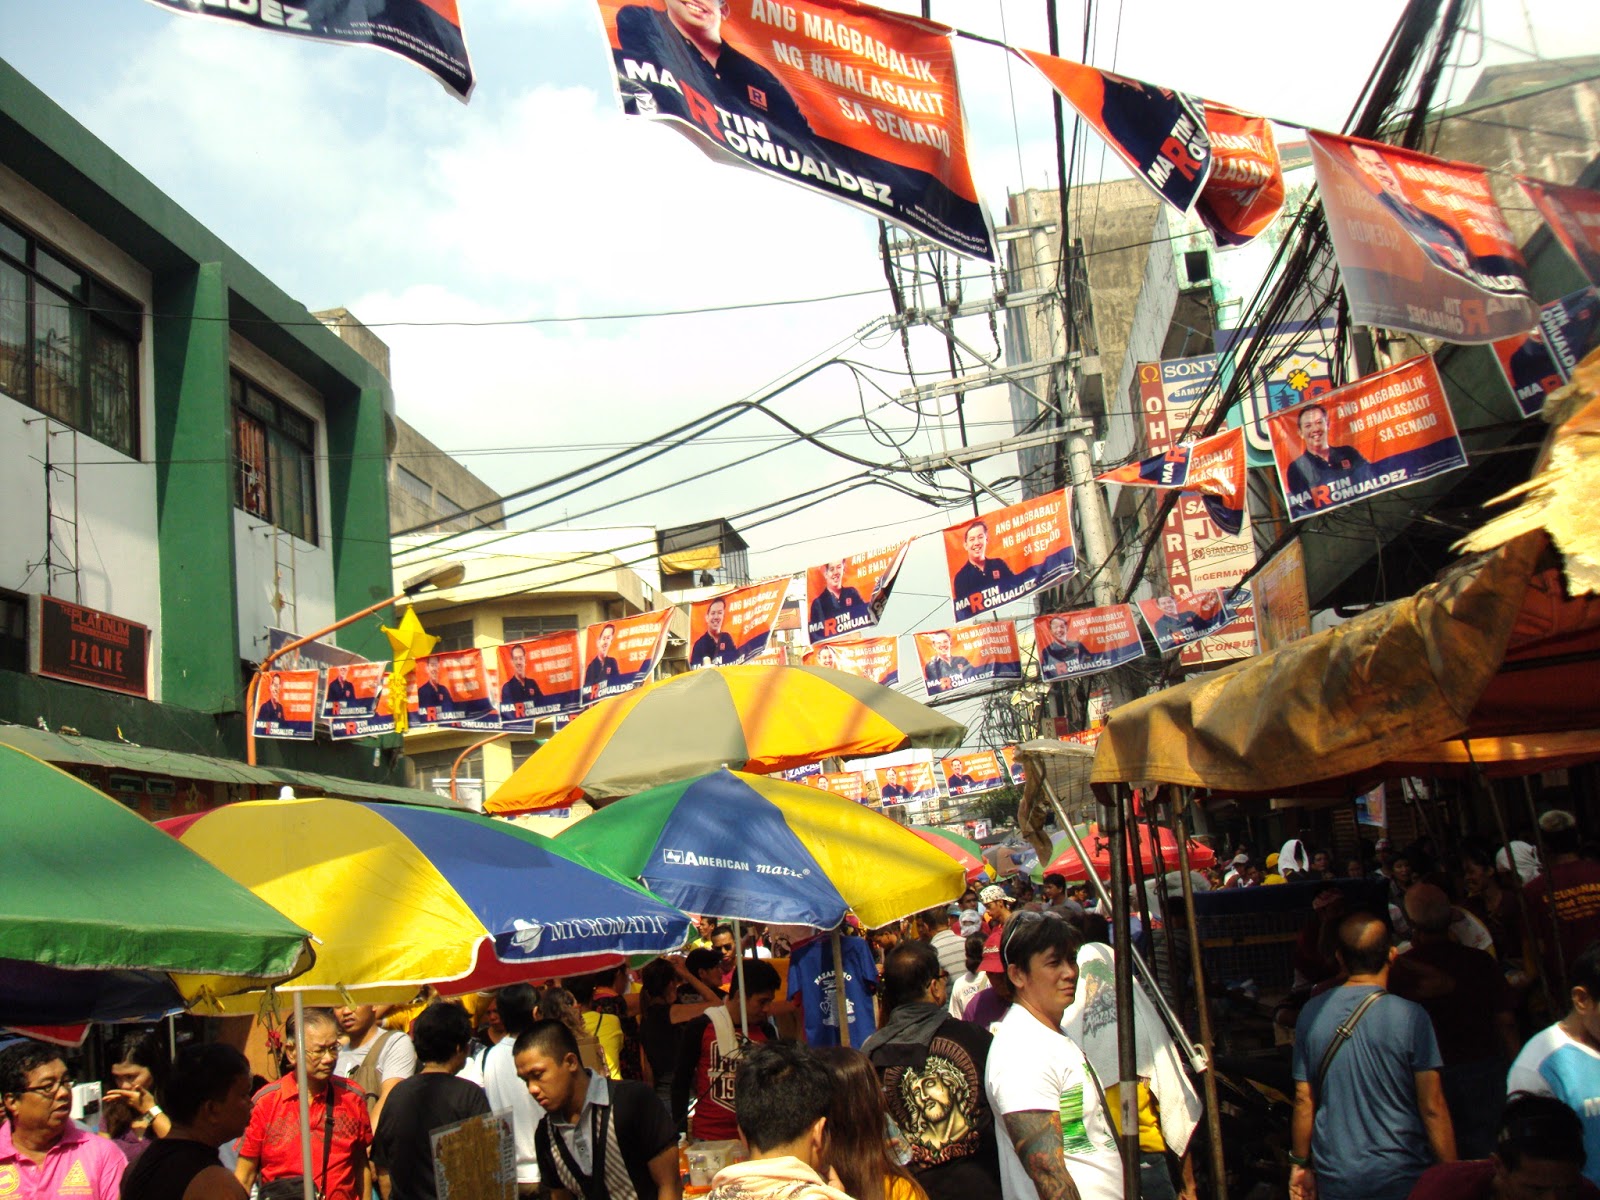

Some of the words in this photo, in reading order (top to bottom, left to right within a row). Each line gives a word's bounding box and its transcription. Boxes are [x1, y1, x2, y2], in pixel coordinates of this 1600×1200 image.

[751, 0, 798, 31] ANG
[804, 11, 937, 83] MAGBABALIK
[772, 40, 805, 71] NG
[811, 53, 946, 117] #MALASAKIT
[837, 96, 871, 126] SA
[875, 108, 950, 157] SENADO
[1164, 360, 1218, 378] SONY
[1337, 403, 1358, 420] ANG
[1360, 375, 1426, 410] MAGBABALIK
[1350, 417, 1365, 434] NG
[1366, 394, 1431, 429] #MALASAKIT
[1380, 427, 1394, 443] SA
[1397, 413, 1438, 438] SENADO
[995, 521, 1011, 536] ANG
[1002, 535, 1014, 549] NG
[1023, 545, 1033, 557] SA
[1205, 544, 1249, 556] STANDARD
[549, 914, 669, 942] MICROMATIC
